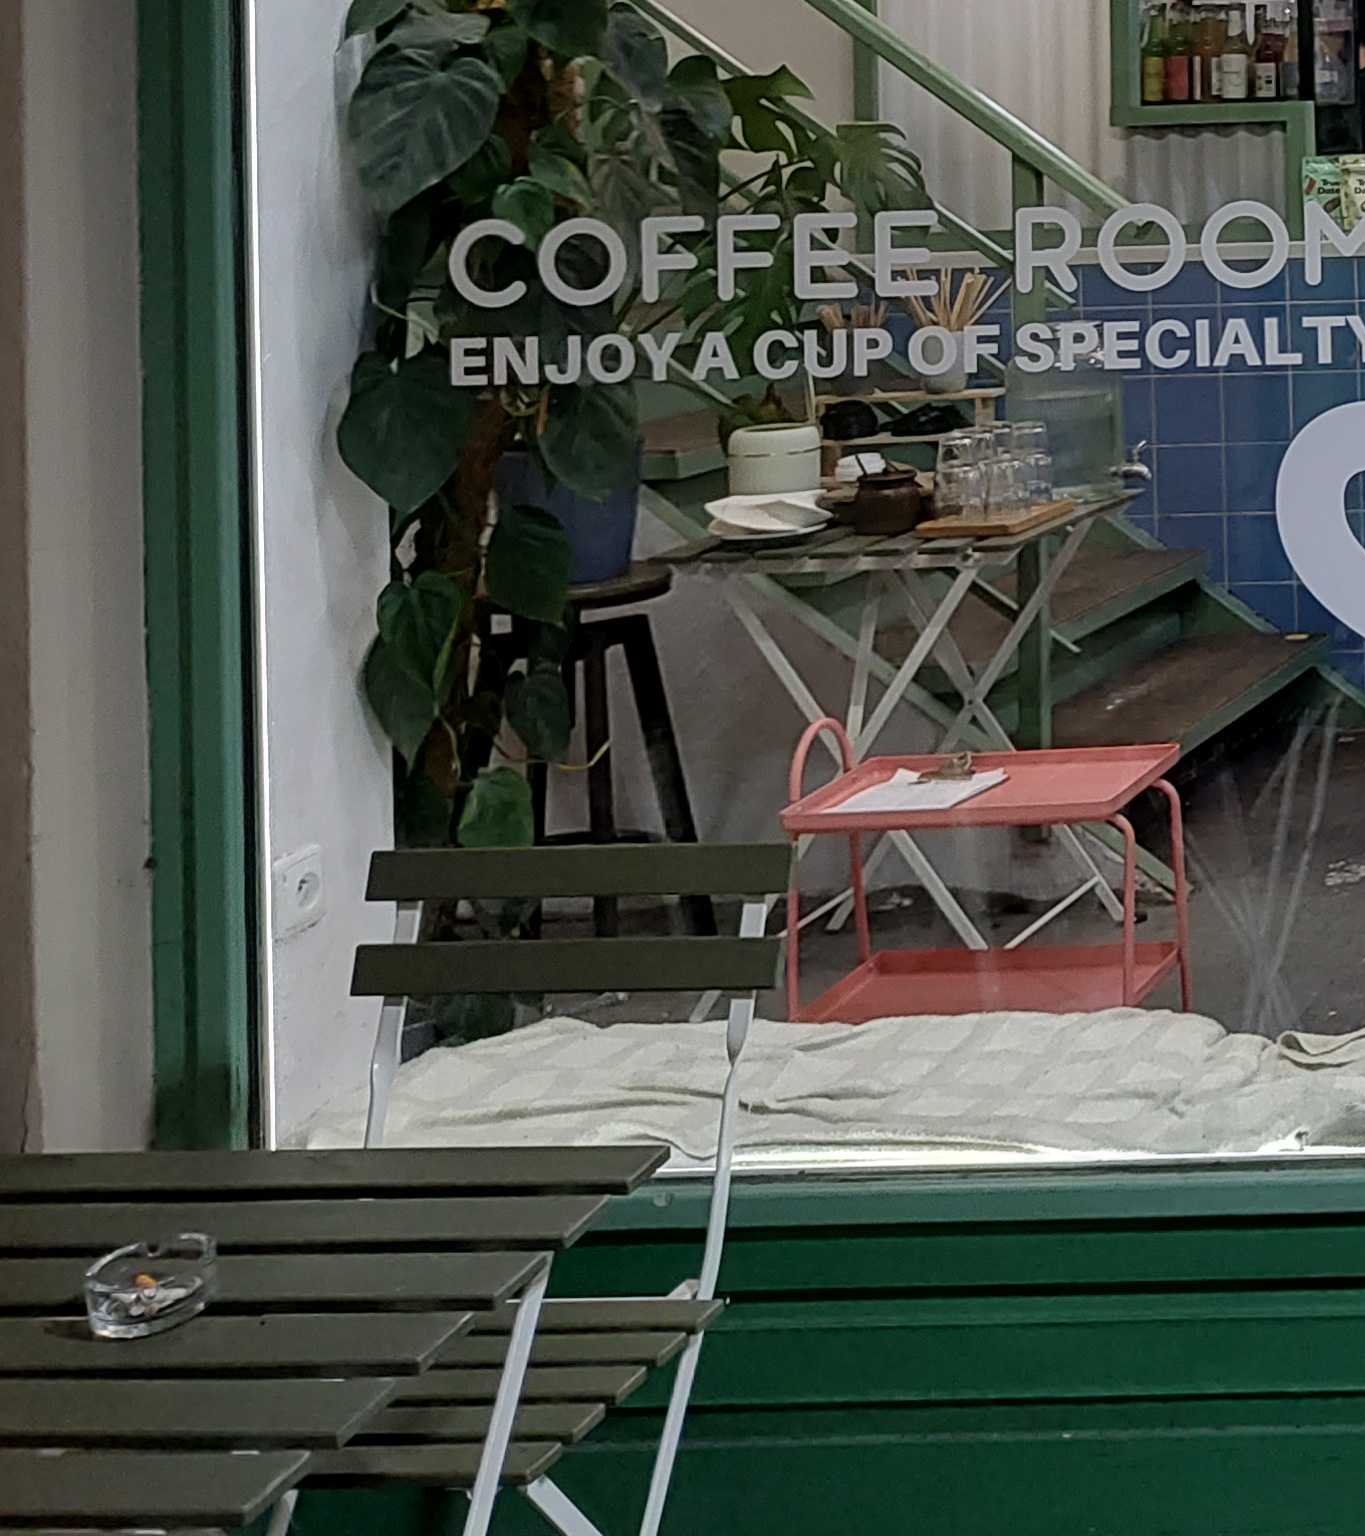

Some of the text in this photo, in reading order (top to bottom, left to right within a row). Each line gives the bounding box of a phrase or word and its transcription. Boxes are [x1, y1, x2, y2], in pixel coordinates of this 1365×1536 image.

[449, 210, 940, 308] COFFEE
[450, 330, 684, 386] ENJOY
[691, 331, 741, 381] A
[752, 327, 893, 380] CUP
[908, 325, 1001, 376] OF
